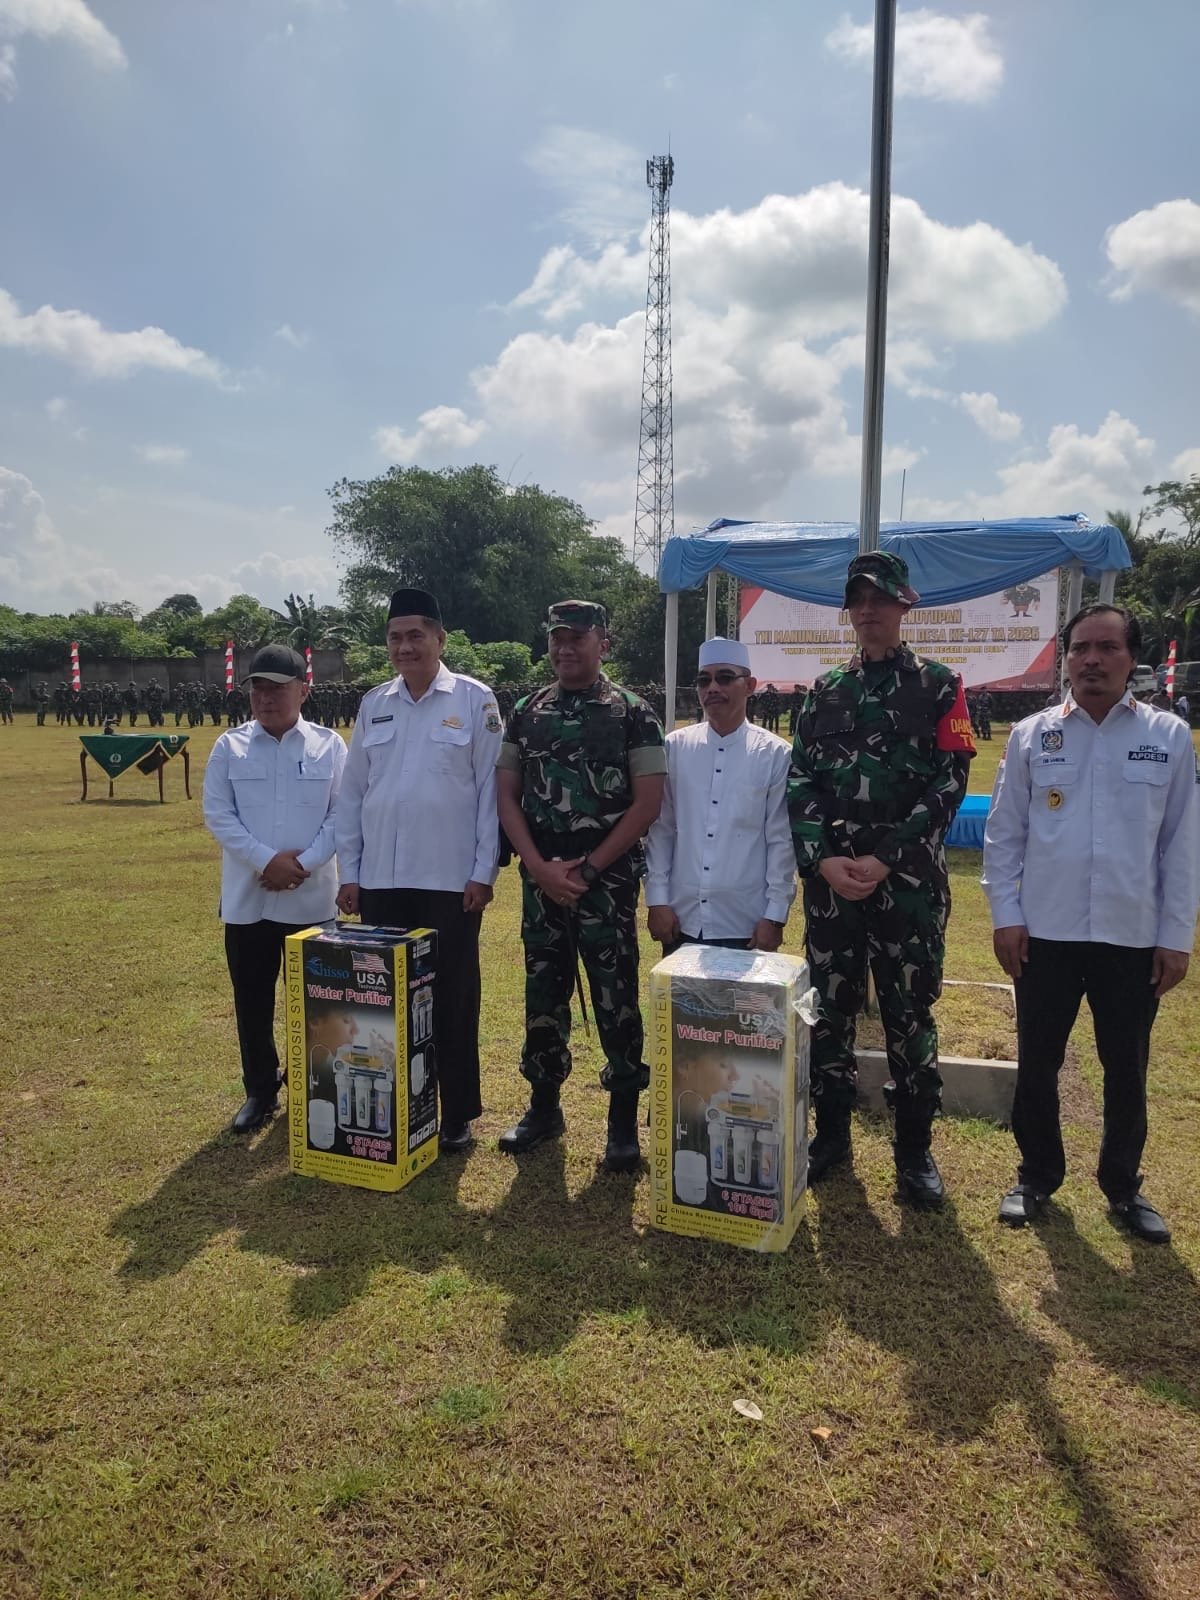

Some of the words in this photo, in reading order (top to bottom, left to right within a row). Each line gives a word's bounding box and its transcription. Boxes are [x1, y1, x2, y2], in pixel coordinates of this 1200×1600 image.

[901, 609, 962, 625] ENUTUPAN
[774, 630, 841, 644] MANUNGGAL
[916, 628, 946, 642] DESA
[949, 627, 990, 642] KE-127
[1008, 627, 1040, 641] 2026
[1130, 752, 1166, 761] APDESI
[290, 951, 300, 1013] SYSTEM
[356, 972, 387, 986] USA
[307, 984, 343, 1000] Water
[345, 988, 392, 1006] Purifier
[677, 1024, 721, 1043] Water
[724, 1030, 782, 1050] Purifier
[291, 1021, 302, 1091] OSMOSIS
[655, 1063, 668, 1140] OSMOSIS
[294, 1097, 304, 1170] REVERSE
[373, 1165, 394, 1173] System
[655, 1147, 668, 1226] REVERSE
[695, 1211, 721, 1222] Reverse
